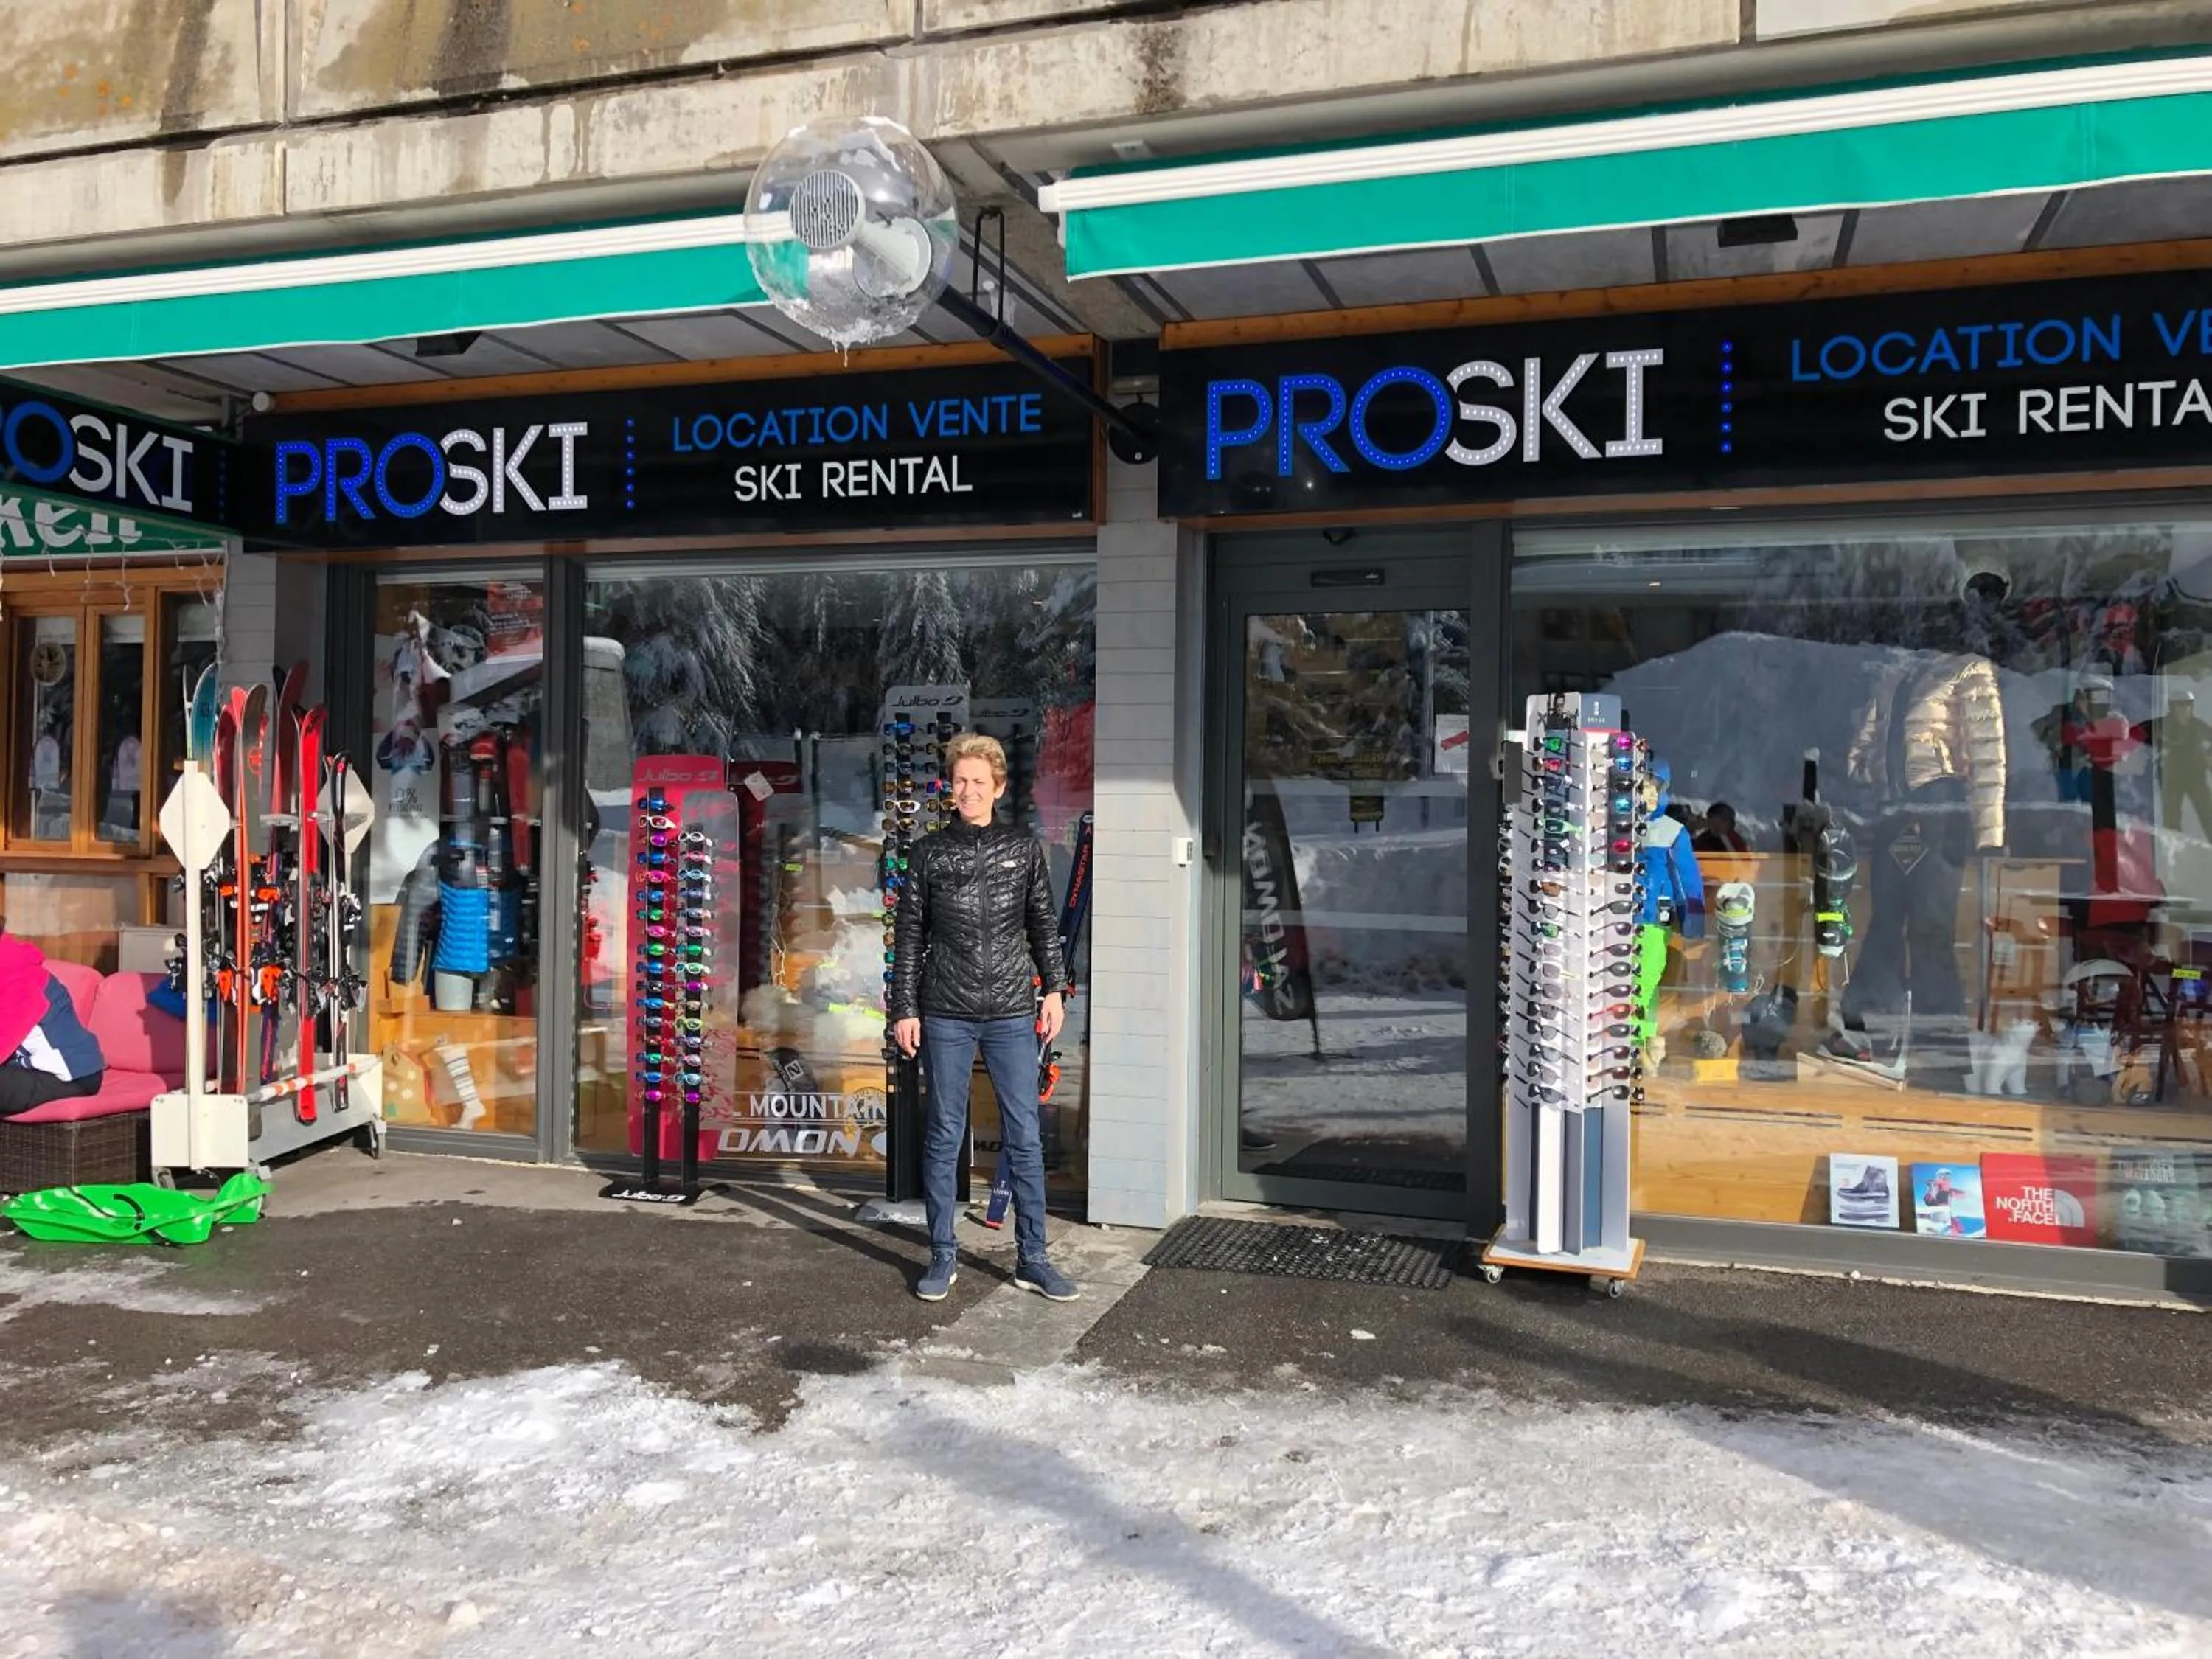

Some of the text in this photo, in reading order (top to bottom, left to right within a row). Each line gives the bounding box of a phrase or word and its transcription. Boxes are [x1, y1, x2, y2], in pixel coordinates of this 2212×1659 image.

[1792, 314, 2121, 381] LOCATION
[673, 394, 1043, 452] LOCATION VENTE
[1206, 348, 1664, 480] PROSKI
[1884, 392, 1987, 442] SKI
[0, 400, 194, 512] OSKI
[276, 422, 588, 524] PROSKI
[734, 455, 973, 501] SKI RENTAL
[891, 696, 939, 707] Julbo
[637, 767, 692, 782] Julbo
[717, 1127, 861, 1158] OMON
[1995, 1197, 2053, 1213] NORTH
[2022, 1186, 2053, 1200] THE
